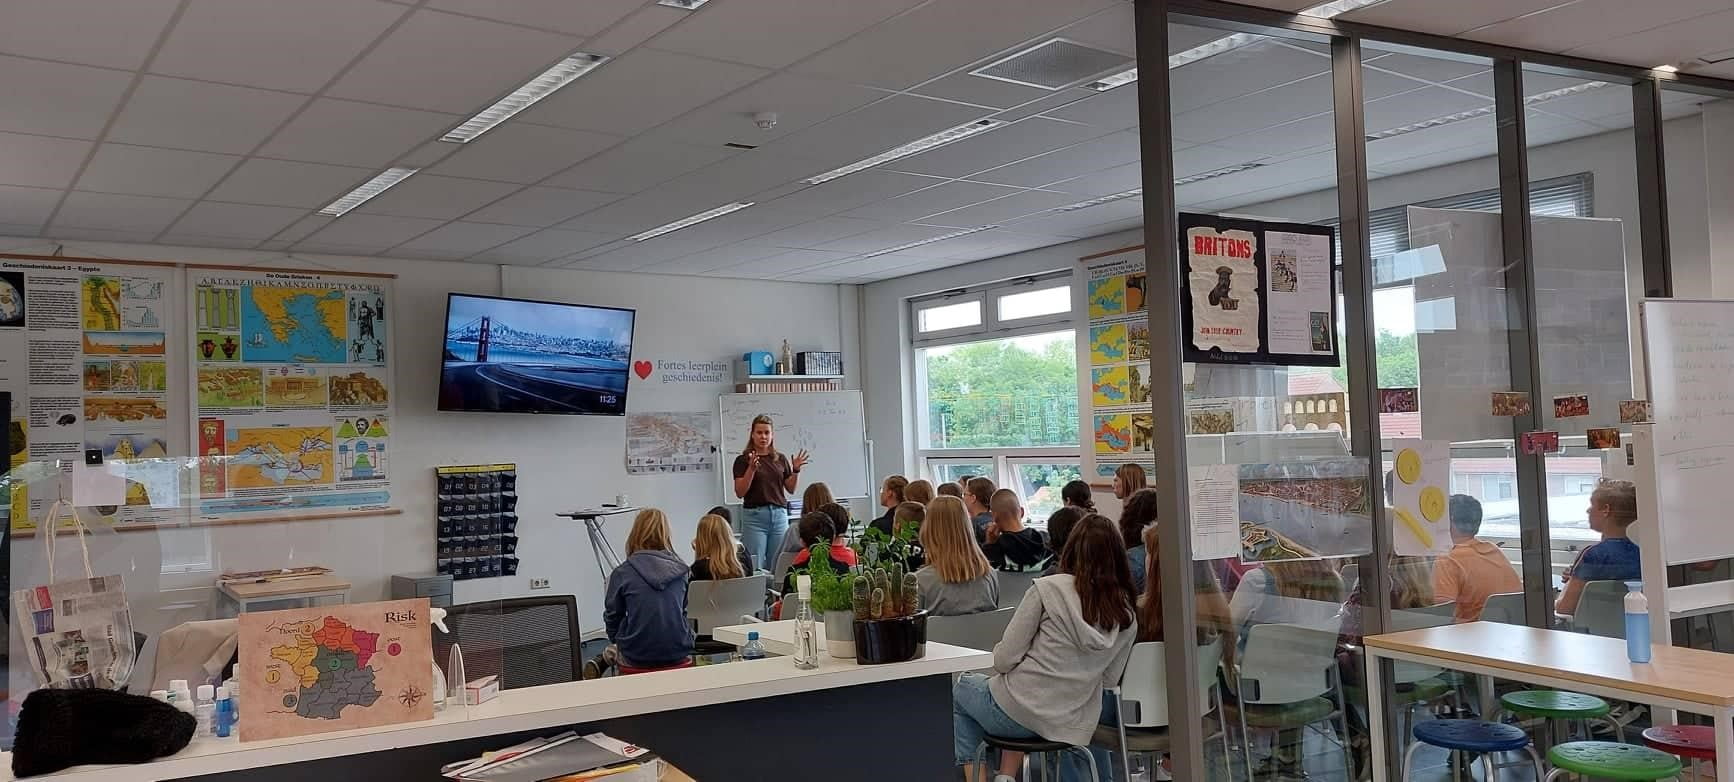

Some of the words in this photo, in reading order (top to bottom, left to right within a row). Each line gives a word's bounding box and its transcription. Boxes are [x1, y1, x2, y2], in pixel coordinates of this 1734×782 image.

[1194, 235, 1252, 259] BRITONS
[657, 359, 687, 371] Fortes
[688, 360, 728, 373] leerplein
[662, 372, 723, 384] geschiedenis!
[385, 610, 417, 623] Risk
